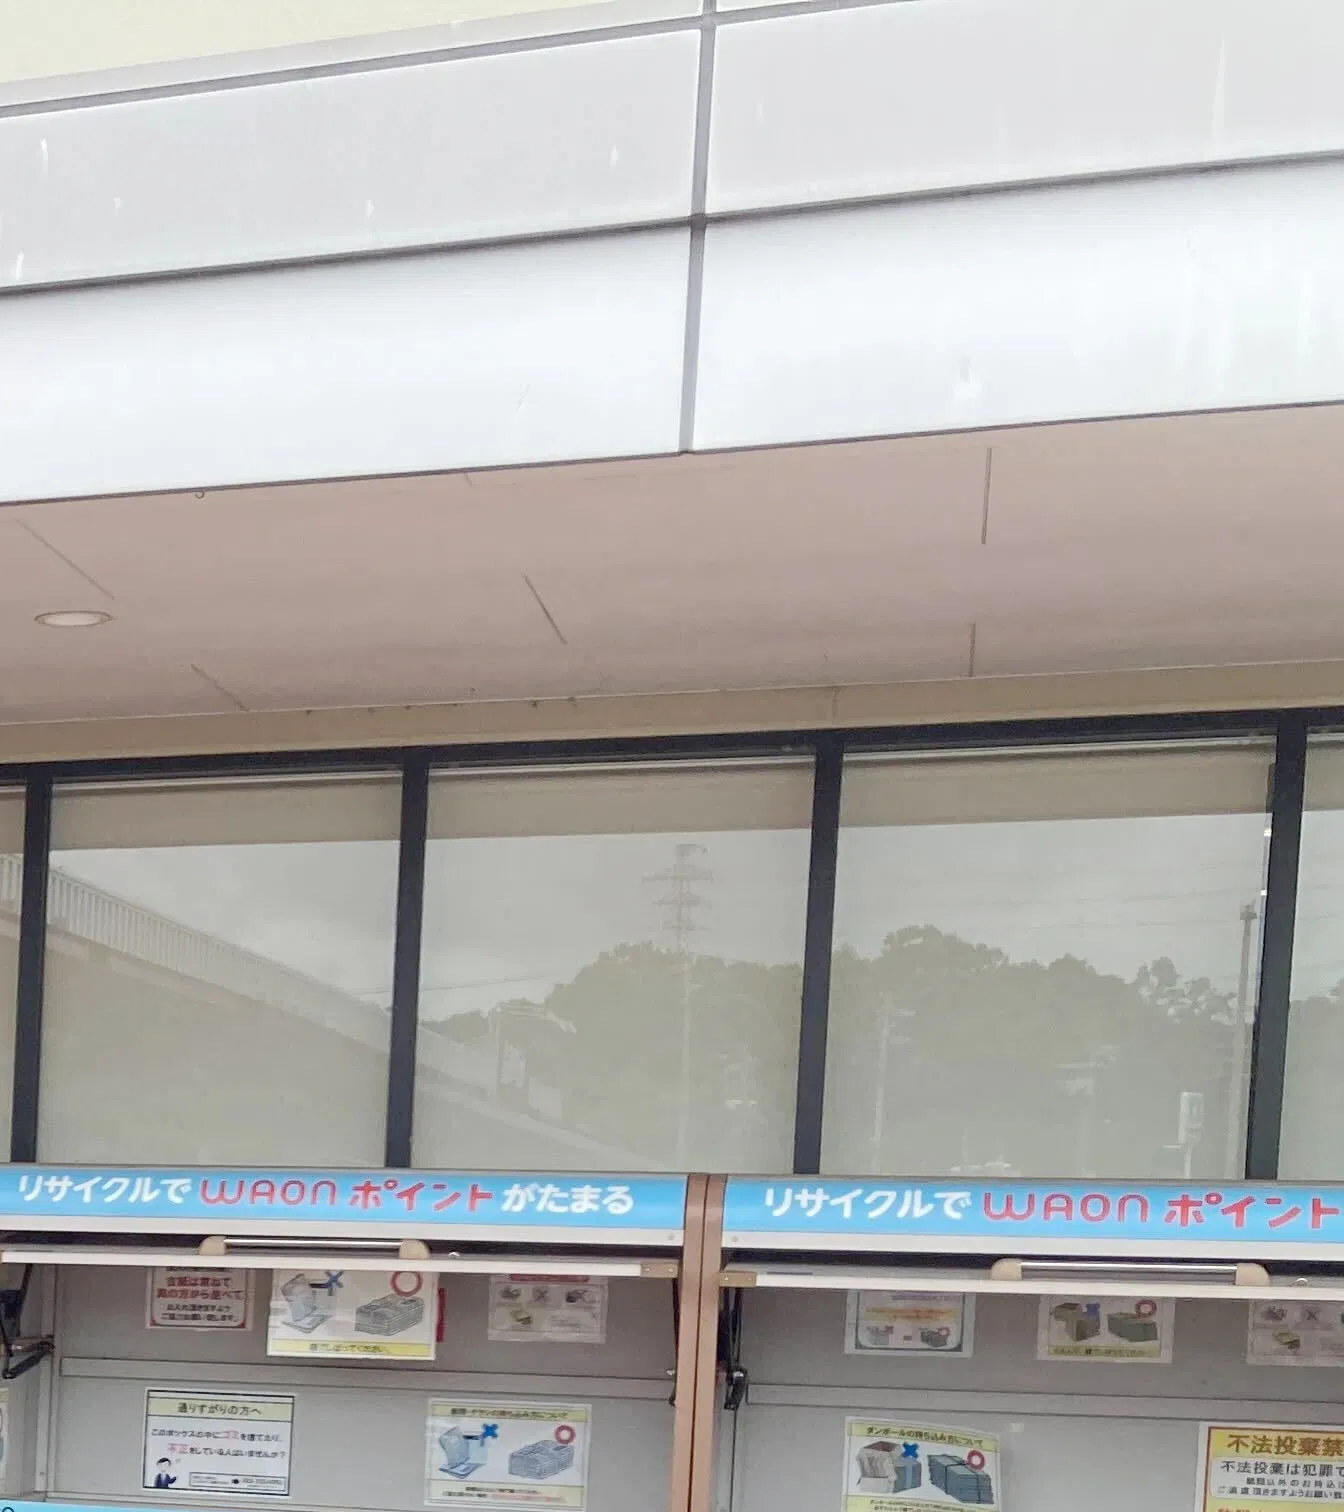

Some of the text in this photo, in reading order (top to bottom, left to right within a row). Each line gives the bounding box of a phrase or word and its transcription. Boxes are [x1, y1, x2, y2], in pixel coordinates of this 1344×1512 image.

[18, 1174, 191, 1206] リサイクルで
[198, 1178, 338, 1207] WAON
[502, 1183, 634, 1215] がたまる
[763, 1188, 972, 1221] リサイクルで
[983, 1191, 1148, 1224] WAON
